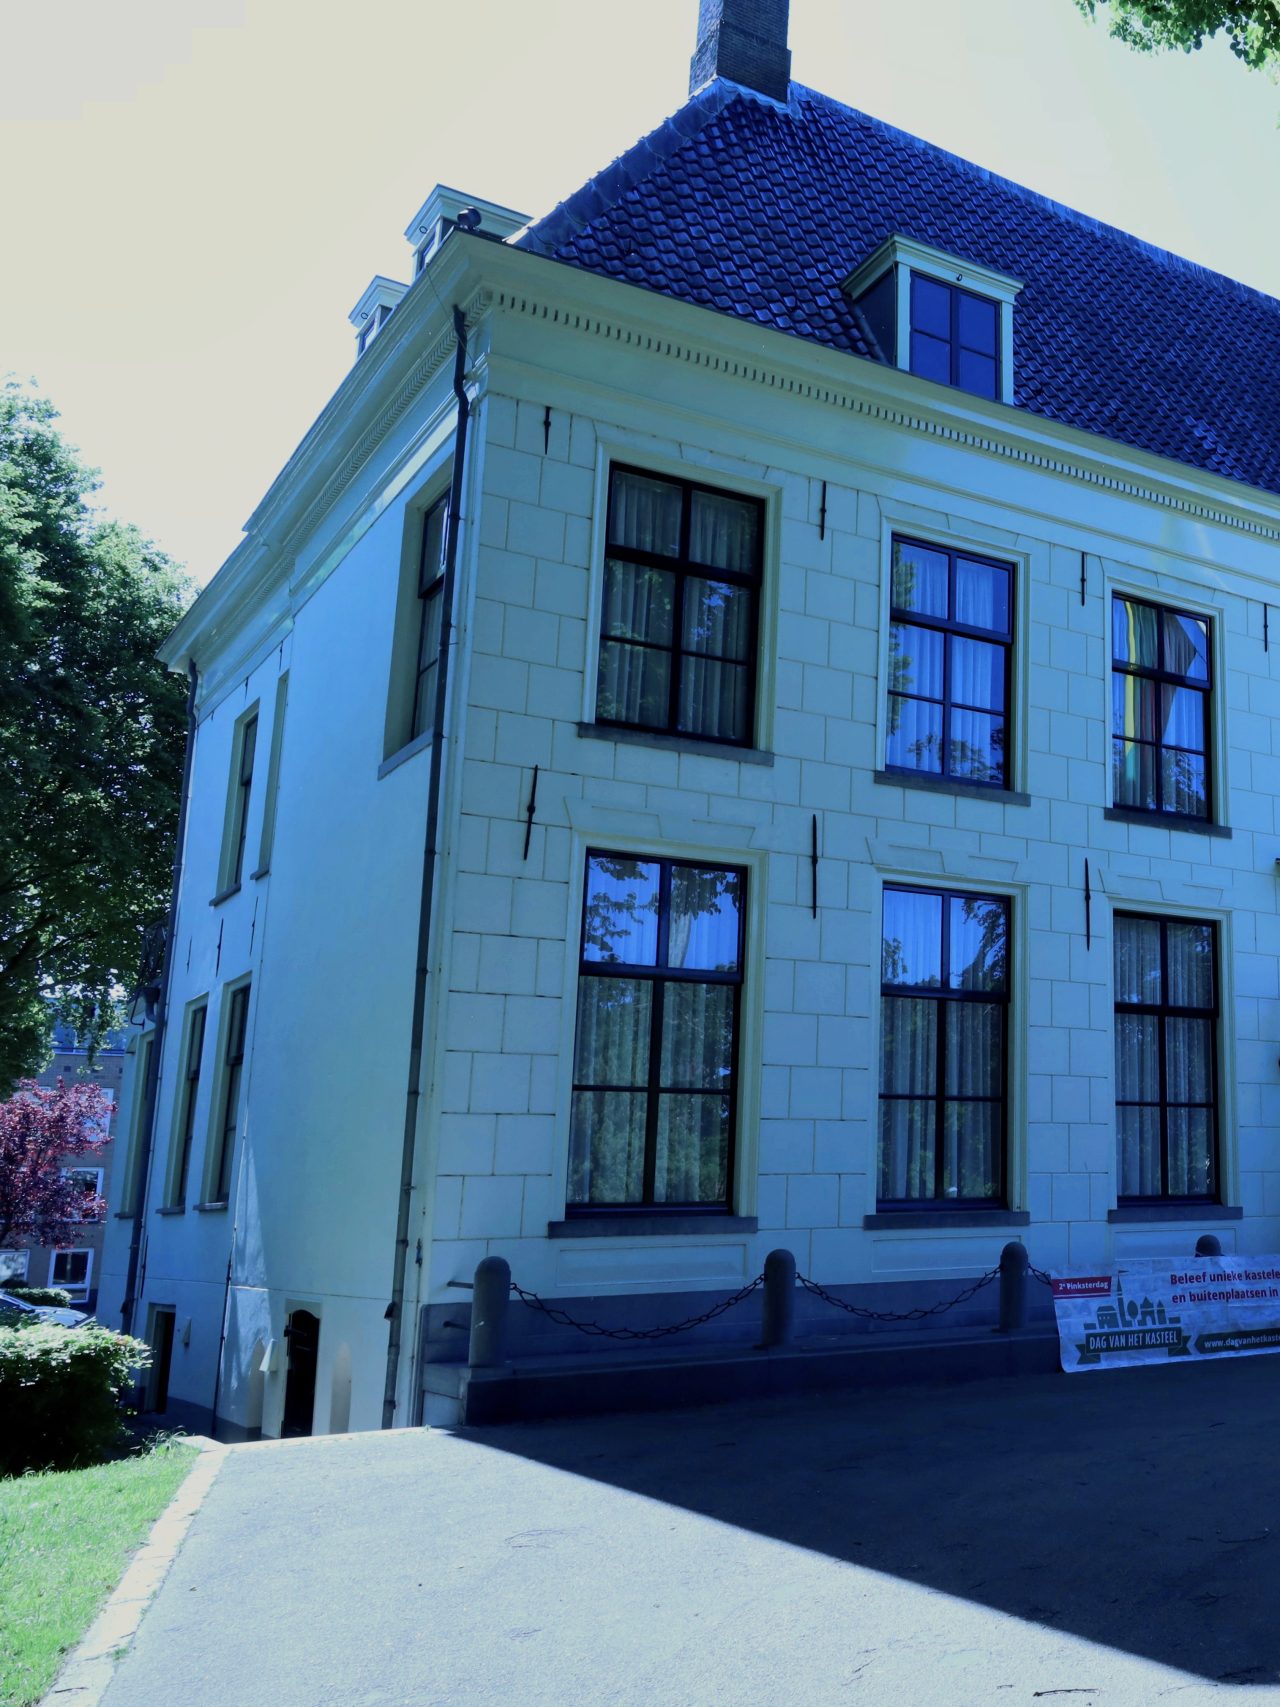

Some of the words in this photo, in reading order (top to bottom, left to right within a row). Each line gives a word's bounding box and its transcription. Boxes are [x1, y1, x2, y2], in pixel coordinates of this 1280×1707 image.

[1067, 1281, 1108, 1290] Pinksterdag
[1170, 1272, 1206, 1285] Beleef
[1210, 1270, 1242, 1282] unieke
[1172, 1294, 1186, 1304] en
[1189, 1288, 1267, 1303] buitenplaatsen
[1269, 1286, 1279, 1297] in
[1089, 1337, 1107, 1350] DAG
[1109, 1334, 1126, 1347] VAN
[1128, 1332, 1144, 1346] HET
[1145, 1330, 1178, 1344] KASTEEL
